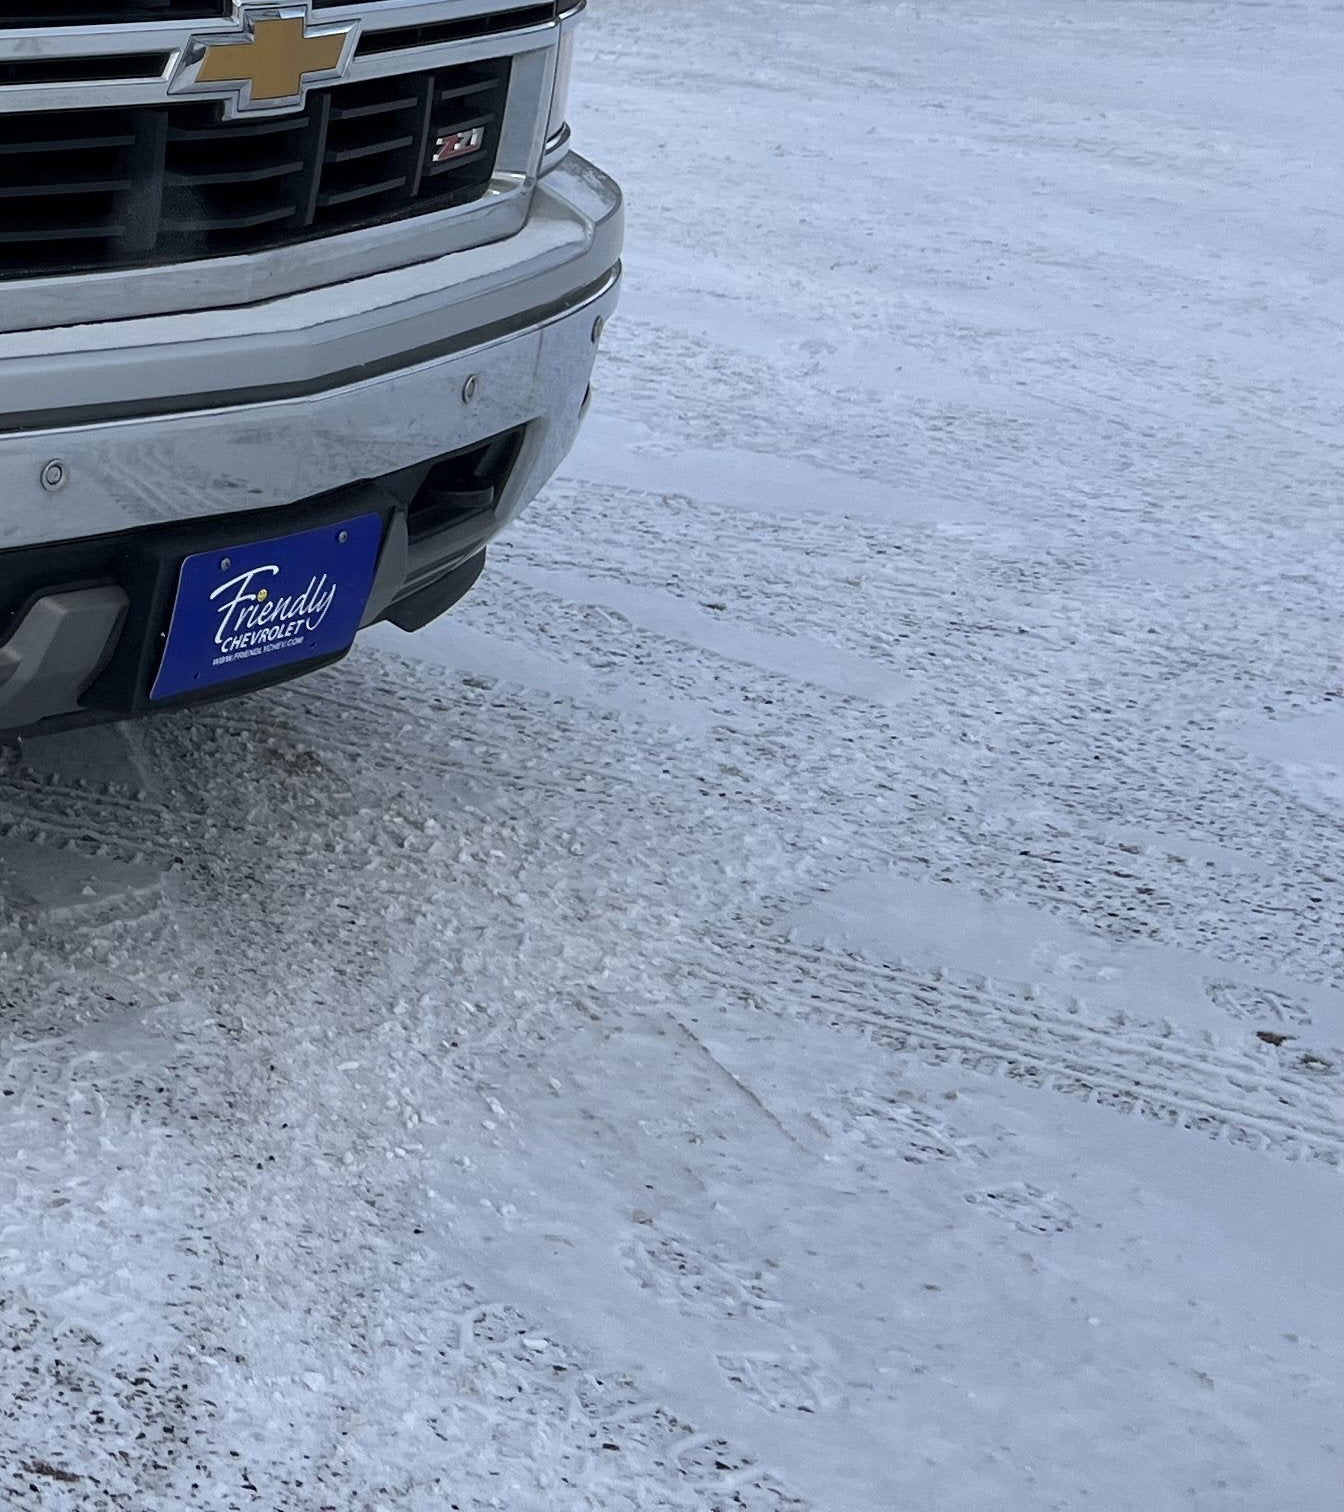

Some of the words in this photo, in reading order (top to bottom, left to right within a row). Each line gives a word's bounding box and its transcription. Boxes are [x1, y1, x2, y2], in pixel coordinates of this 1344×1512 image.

[432, 126, 485, 162] Z71
[210, 565, 337, 644] Friendly
[221, 619, 305, 653] CHEVROLET
